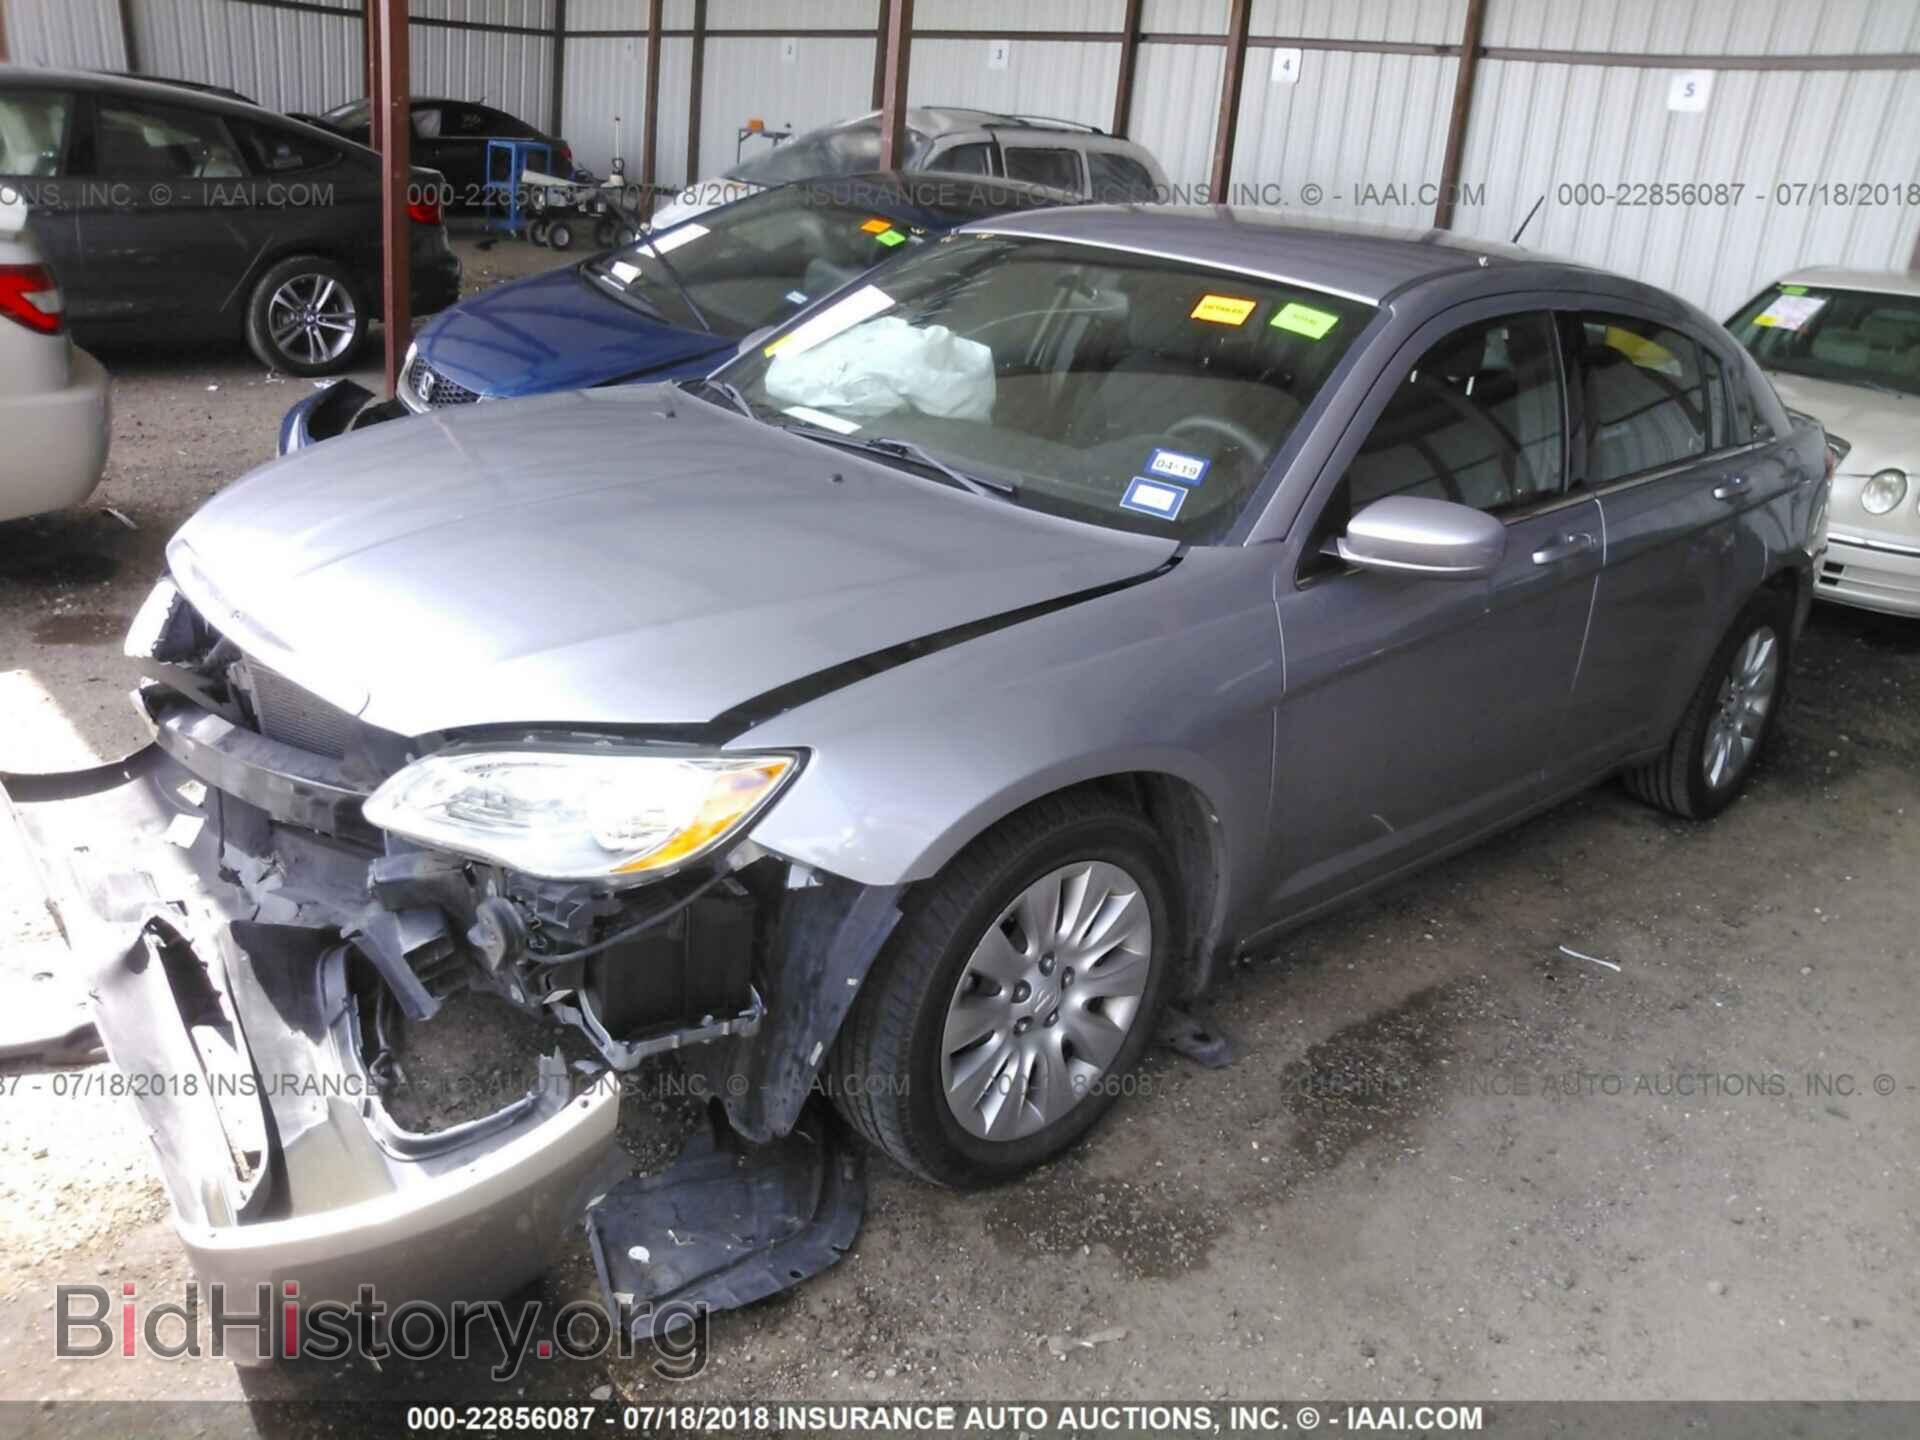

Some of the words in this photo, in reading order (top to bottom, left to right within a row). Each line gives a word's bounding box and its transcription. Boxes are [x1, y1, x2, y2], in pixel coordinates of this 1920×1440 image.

[997, 49, 1003, 60] 3
[1282, 60, 1290, 72] 4
[1683, 82, 1695, 97] 5
